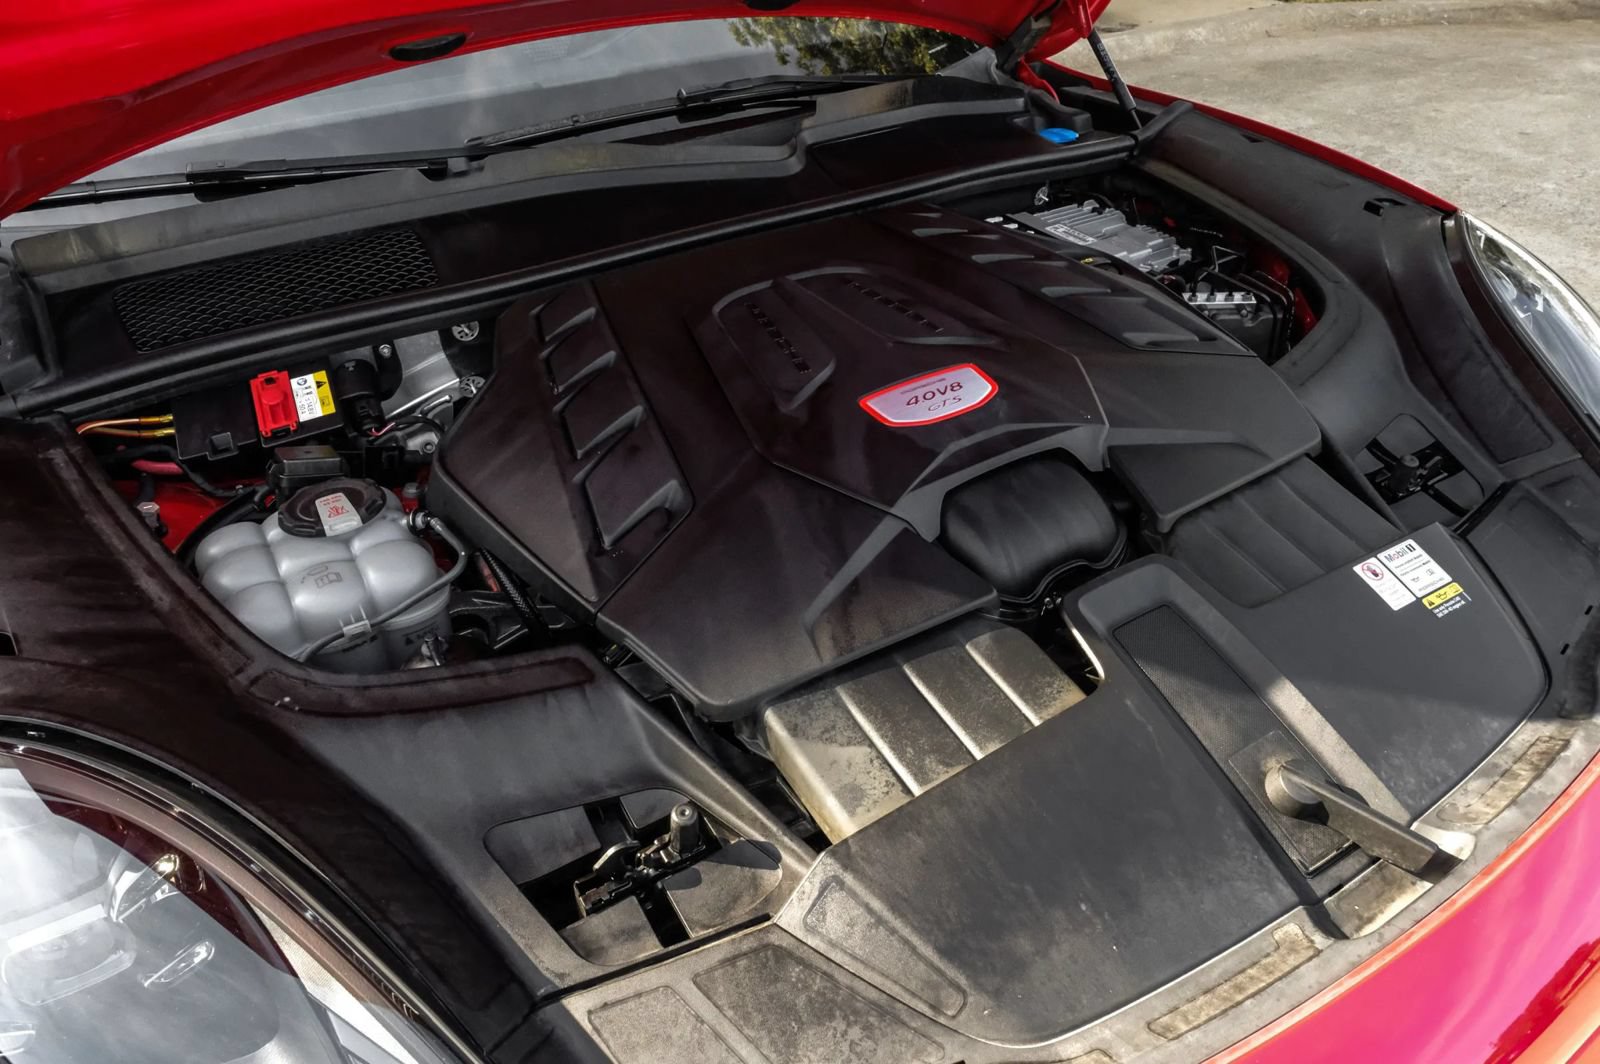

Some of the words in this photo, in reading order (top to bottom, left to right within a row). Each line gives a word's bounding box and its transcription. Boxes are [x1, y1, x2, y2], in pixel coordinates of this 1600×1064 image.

[906, 381, 963, 406] 4.0V8
[928, 395, 962, 412] GTS
[1384, 547, 1409, 563] Mobil
